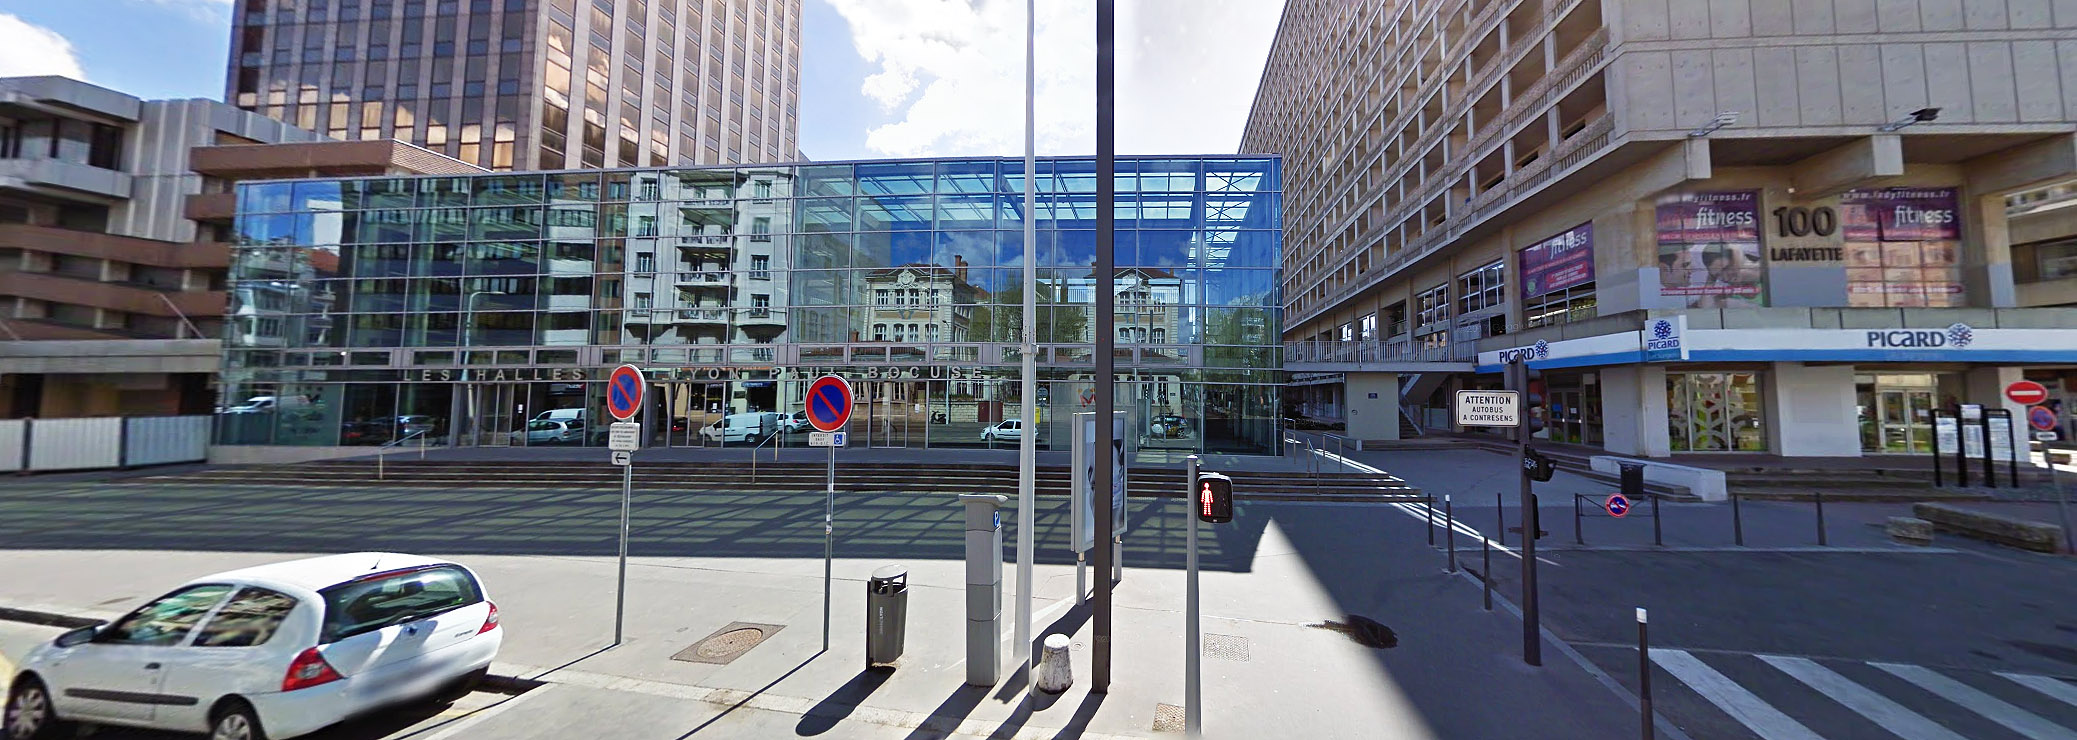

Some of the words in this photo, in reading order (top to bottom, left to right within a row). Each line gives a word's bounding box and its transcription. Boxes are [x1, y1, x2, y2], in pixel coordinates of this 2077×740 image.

[1696, 206, 1754, 230] fitness
[1773, 206, 1837, 238] 100
[1894, 205, 1954, 229] fitness
[1770, 247, 1844, 262] LAFAYETTE
[403, 369, 450, 381] LES
[476, 368, 582, 381] HALLES
[868, 366, 983, 379] BOCUSE
[1465, 396, 1511, 405] ATTENTION
[1472, 406, 1504, 414] AUTOBUS
[1470, 414, 1514, 422] CONTRESENS
